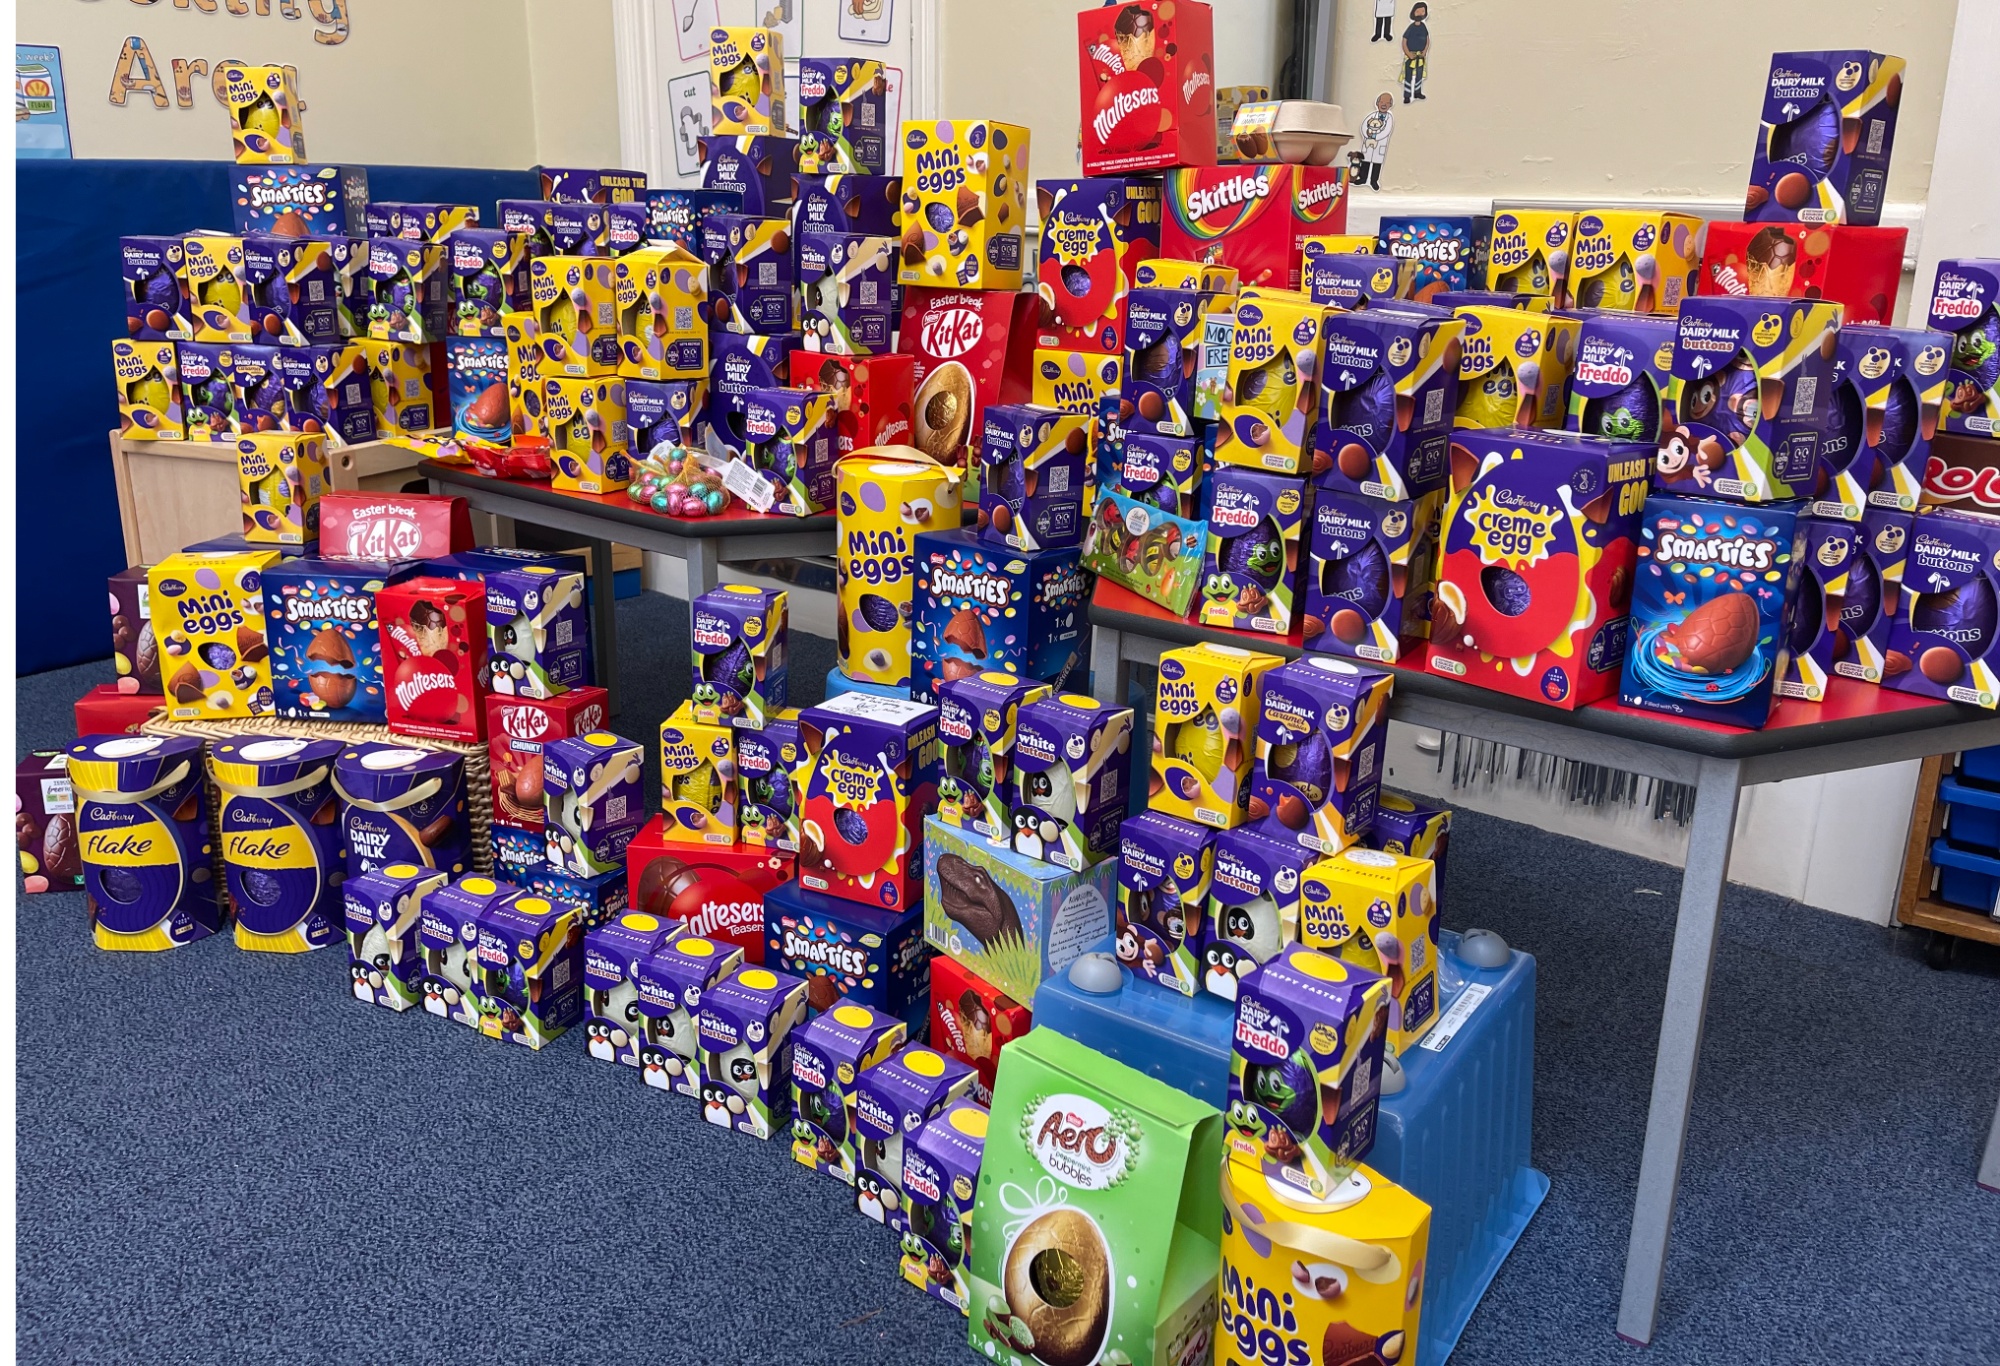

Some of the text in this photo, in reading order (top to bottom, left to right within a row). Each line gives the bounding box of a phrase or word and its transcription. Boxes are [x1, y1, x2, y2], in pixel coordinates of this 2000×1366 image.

[801, 84, 826, 96] Freddo
[1183, 71, 1210, 104] Maltesers
[1772, 77, 1825, 88] DAIRY MILK
[684, 87, 696, 98] cut
[1774, 88, 1819, 98] buttons
[1093, 87, 1159, 144] Maltesers
[717, 163, 739, 172] DAIRY
[916, 144, 960, 173] Mini
[600, 176, 645, 188] UNLEASH THE
[916, 168, 966, 193] eggs
[1187, 175, 1269, 221] Skittles
[1298, 181, 1343, 210] Skittles
[1056, 228, 1095, 242] creme
[1577, 232, 1612, 253] Mini
[1062, 240, 1088, 255] egg
[455, 257, 483, 268] Freddo
[1492, 248, 1529, 266] eggs
[1575, 251, 1614, 270] eggs
[370, 262, 397, 273] Freddo
[533, 274, 555, 290] Mini
[1939, 281, 1966, 292] DAIRY
[930, 293, 984, 309] Easter break
[1938, 289, 1960, 298] MILK
[1934, 298, 1980, 316] Freddo
[926, 311, 981, 357] KitKat
[1235, 326, 1272, 344] Mini
[1680, 326, 1740, 340] DAIRY MILK
[1234, 343, 1275, 362] eggs
[1584, 345, 1614, 357] DAIRY
[1683, 338, 1734, 352] buttons
[1207, 347, 1230, 367] FRE
[1331, 353, 1373, 369] buttons
[1582, 353, 1606, 363] MILK
[182, 366, 209, 376] Freddo
[725, 362, 751, 374] DAIRY
[727, 373, 747, 382] MILK
[1053, 379, 1094, 403] Mini
[549, 407, 572, 419] eggs
[747, 421, 776, 434] Freddo
[987, 436, 1012, 449] buttons
[240, 453, 266, 467] Mini
[242, 465, 270, 476] eggs
[1124, 466, 1159, 481] Freddo
[1608, 458, 1646, 483] UNLEASH
[1496, 489, 1540, 513] Cadbury
[1618, 480, 1648, 516] GOO
[353, 504, 416, 520] Easter break
[1213, 508, 1257, 526] Freddo
[1318, 515, 1348, 528] DAIRY
[1478, 512, 1547, 538] creme
[1321, 525, 1366, 539] buttons
[848, 527, 906, 557] Mini
[1488, 530, 1532, 556] egg
[1914, 544, 1981, 562] DAIRY MILK
[849, 556, 913, 585] eggs
[1917, 554, 1973, 574] buttons
[177, 590, 234, 618] Mini
[487, 595, 516, 607] white
[183, 609, 244, 635] eggs
[695, 631, 730, 645] Freddo
[395, 670, 455, 711] Maltesers
[1160, 681, 1195, 698] Mini
[1160, 697, 1199, 715] eggs
[1293, 706, 1315, 720] MILK
[507, 706, 548, 738] KitKat
[941, 718, 971, 738] Freddo
[512, 740, 541, 753] CHUNKY
[664, 742, 694, 758] Mini
[1018, 734, 1055, 752] white
[665, 754, 699, 770] eggs
[739, 757, 769, 770] Freddo
[831, 769, 874, 788] creme
[837, 782, 866, 800] egg
[91, 807, 134, 823] Cadbury
[232, 809, 273, 825] Cadbury
[87, 834, 152, 857] flake
[230, 837, 290, 858] flake
[350, 830, 391, 847] DAIRY
[353, 844, 386, 859] MILK
[1124, 856, 1162, 876] buttons
[1217, 861, 1262, 884] white
[1215, 871, 1261, 896] buttons
[345, 902, 372, 917] white
[1304, 903, 1345, 922] Mini
[422, 917, 453, 935] white
[1306, 920, 1350, 940] eggs
[586, 957, 621, 973] white
[640, 983, 675, 1000] white
[1303, 982, 1343, 1004] EASTER
[701, 1017, 737, 1035] white
[1239, 1013, 1264, 1030] MILK
[700, 1026, 737, 1044] buttons
[1237, 1026, 1287, 1057] Freddo
[793, 1063, 825, 1087] Freddo
[858, 1100, 894, 1124] white
[858, 1110, 893, 1135] buttons
[1037, 1111, 1117, 1164] Aero
[1049, 1154, 1092, 1187] bubbles
[1055, 1151, 1092, 1174] peppermint
[905, 1170, 940, 1200] Freddo
[1222, 1255, 1297, 1332] Mini
[1221, 1297, 1311, 1366] eggs
